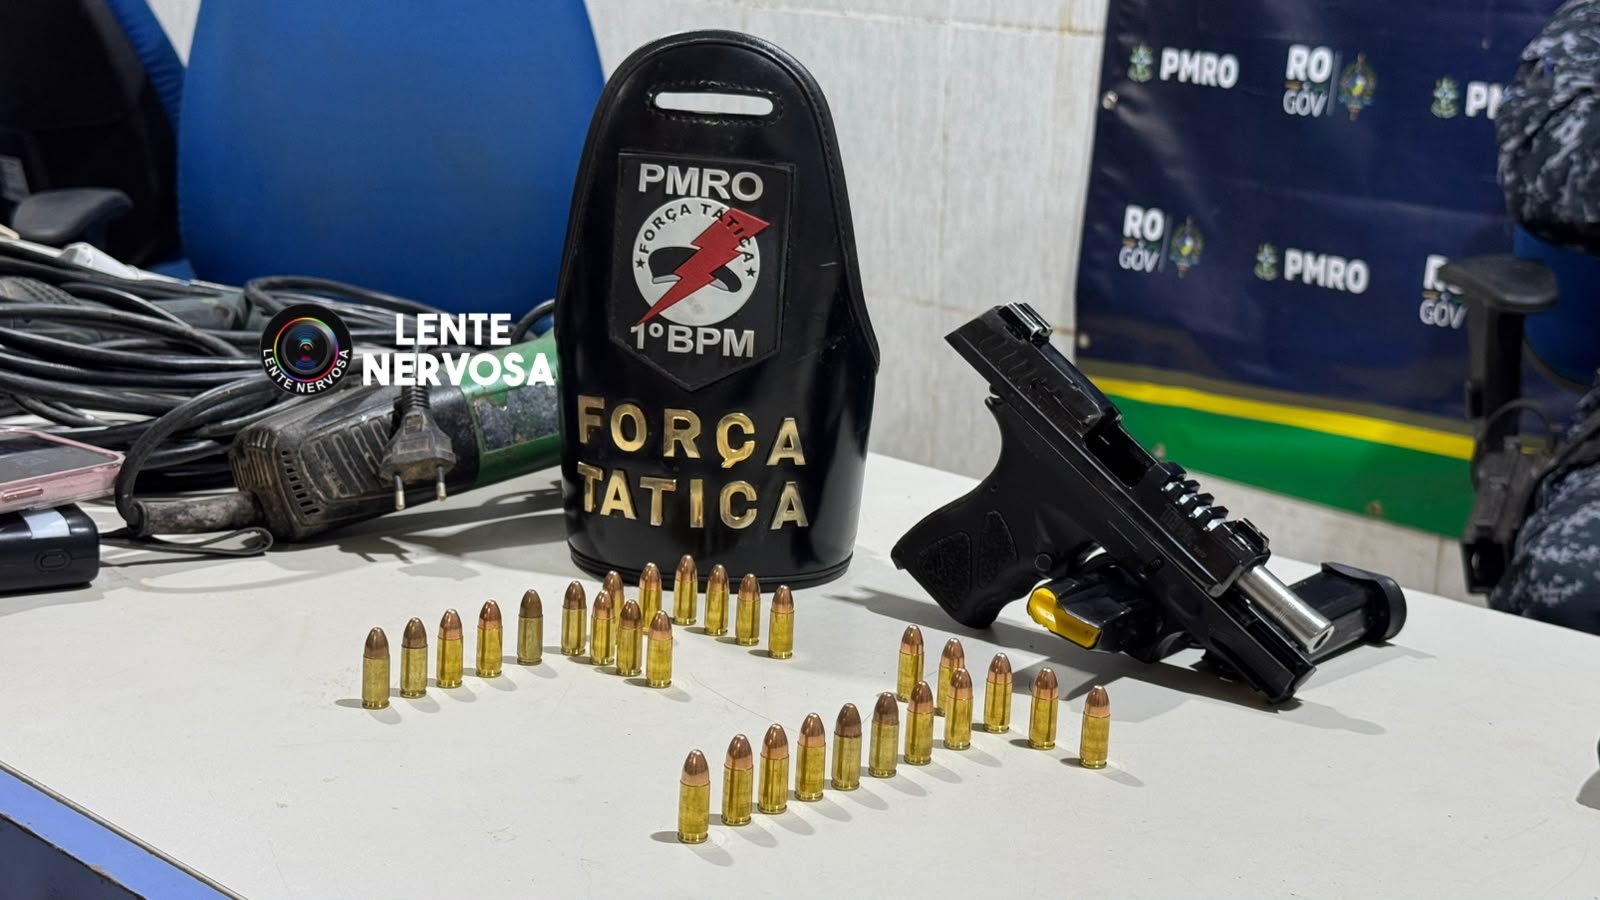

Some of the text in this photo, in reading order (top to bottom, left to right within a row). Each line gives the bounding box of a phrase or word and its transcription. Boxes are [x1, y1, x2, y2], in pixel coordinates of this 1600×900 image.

[1160, 48, 1239, 88] PMRO
[1286, 44, 1334, 83] RO
[638, 163, 764, 202] PMRO
[639, 204, 692, 255] FORÇA
[1123, 204, 1164, 242] RO
[1284, 249, 1369, 294] PMRO
[577, 394, 807, 468] FORÇA
[577, 461, 809, 530] TATICA
